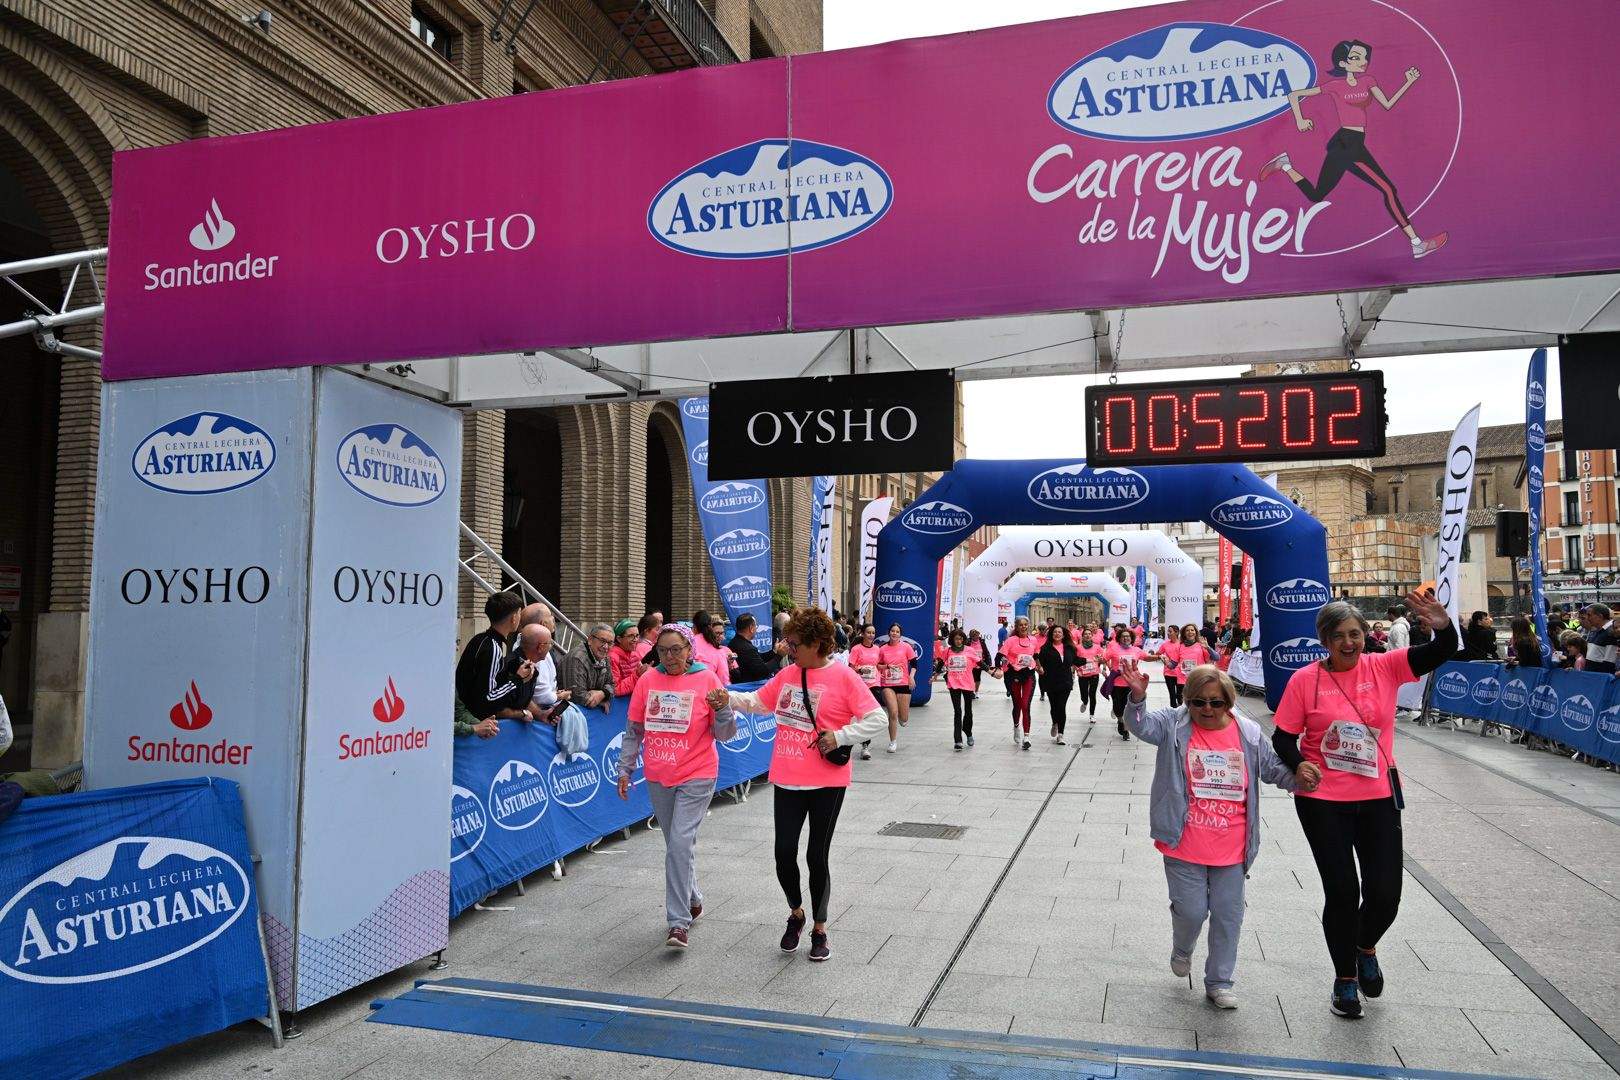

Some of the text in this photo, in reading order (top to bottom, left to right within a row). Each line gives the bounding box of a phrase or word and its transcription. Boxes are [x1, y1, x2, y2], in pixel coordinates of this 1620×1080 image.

[1107, 52, 1286, 82] CENTRAL LECHERA
[1067, 68, 1292, 120] ASTURIANA
[702, 170, 865, 198] CENTRAL LECHERA
[1026, 143, 1243, 204] Carrera
[665, 187, 874, 236] ASTURIANA
[375, 213, 536, 264] OYSHO
[1079, 180, 1332, 284] de la Mujer
[144, 253, 279, 291] Santander
[747, 405, 918, 447] OYSHO
[165, 438, 262, 451] CENTRAL LECHERA
[364, 445, 438, 470] CENTRAL LECHERA
[143, 446, 264, 476] ASTURIANA
[346, 444, 439, 493] ASTURIANA
[1037, 479, 1140, 500] ASTURIANA
[1583, 451, 1592, 503] HOTEL
[906, 513, 967, 526] ASTURIANA
[1218, 510, 1287, 521] ASTURIANA
[1034, 538, 1128, 557] OYSHO
[121, 566, 270, 605] OYSHO
[333, 566, 443, 607] OYSHO
[1271, 592, 1326, 604] ASTURIANA
[1274, 650, 1329, 663] ASTURIAN
[661, 706, 676, 714] 016
[791, 702, 806, 711] 016
[127, 735, 253, 766] Santander
[338, 727, 431, 760] Santander
[649, 748, 677, 763] SUMA
[777, 745, 804, 757] SUMA
[1342, 741, 1362, 750] 016
[553, 769, 598, 796] ASTURIANA
[1207, 769, 1226, 777] 016
[495, 786, 547, 820] ASTURIANA
[1187, 811, 1228, 827] SUMA
[55, 864, 223, 911] CENTRAL LECHERA
[14, 881, 236, 966] ASTURIANA
